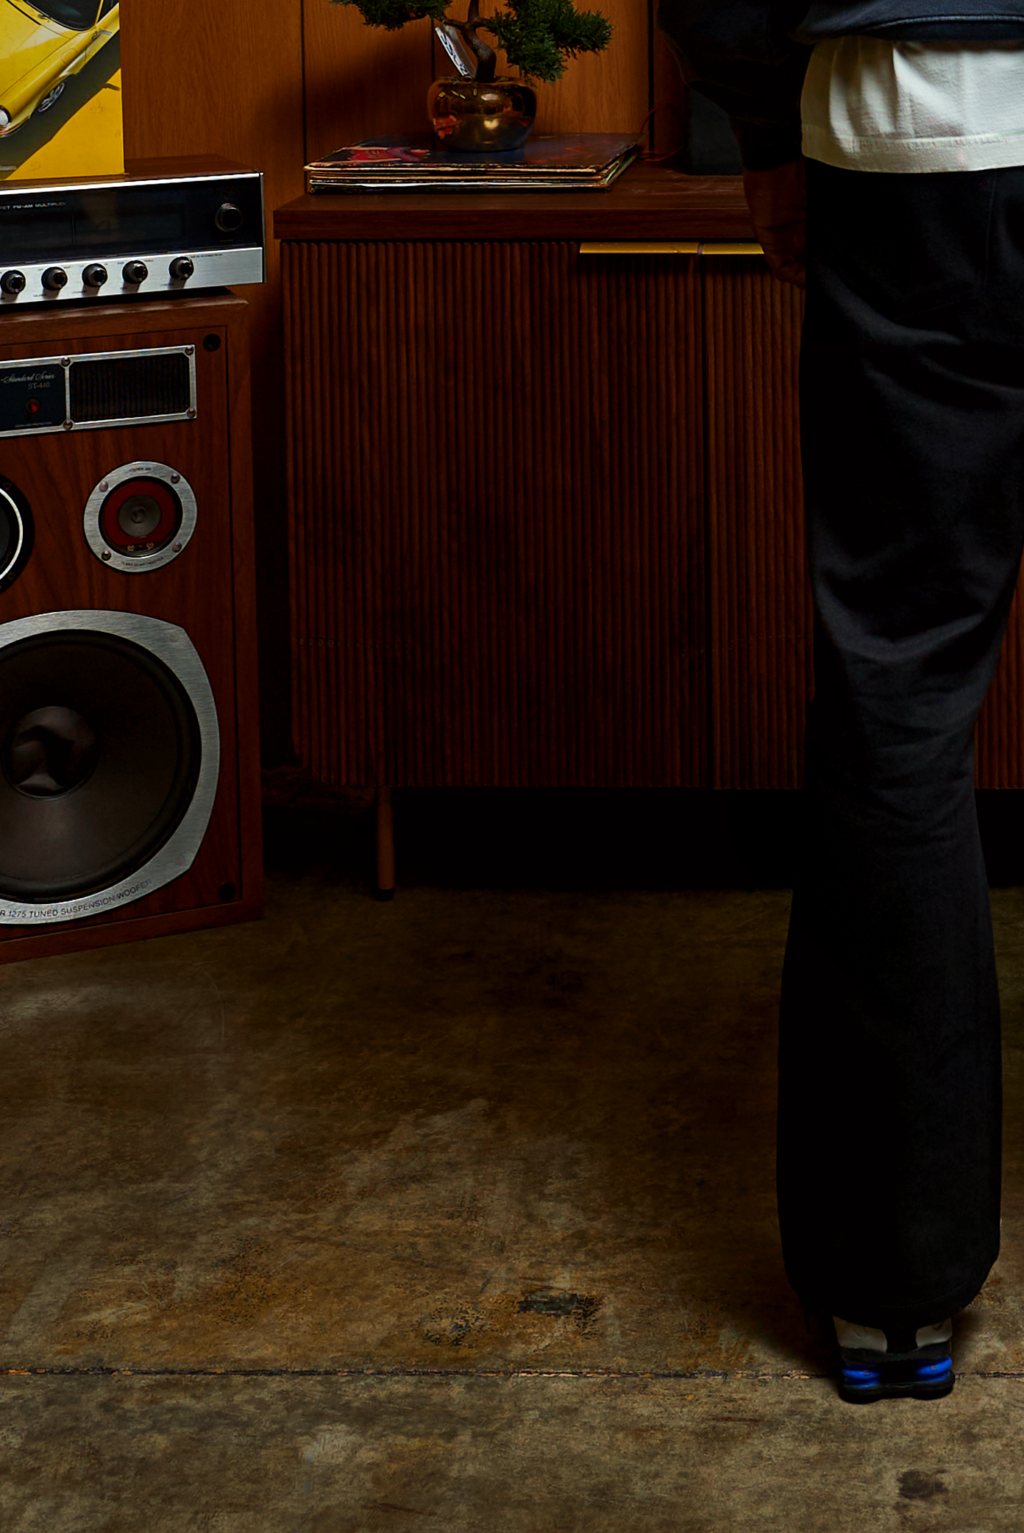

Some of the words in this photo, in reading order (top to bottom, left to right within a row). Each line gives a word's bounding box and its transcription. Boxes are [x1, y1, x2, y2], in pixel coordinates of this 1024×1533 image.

[29, 908, 59, 918] TUNED
[61, 895, 116, 916] SUSPENSION
[116, 878, 153, 899] WOOFER
